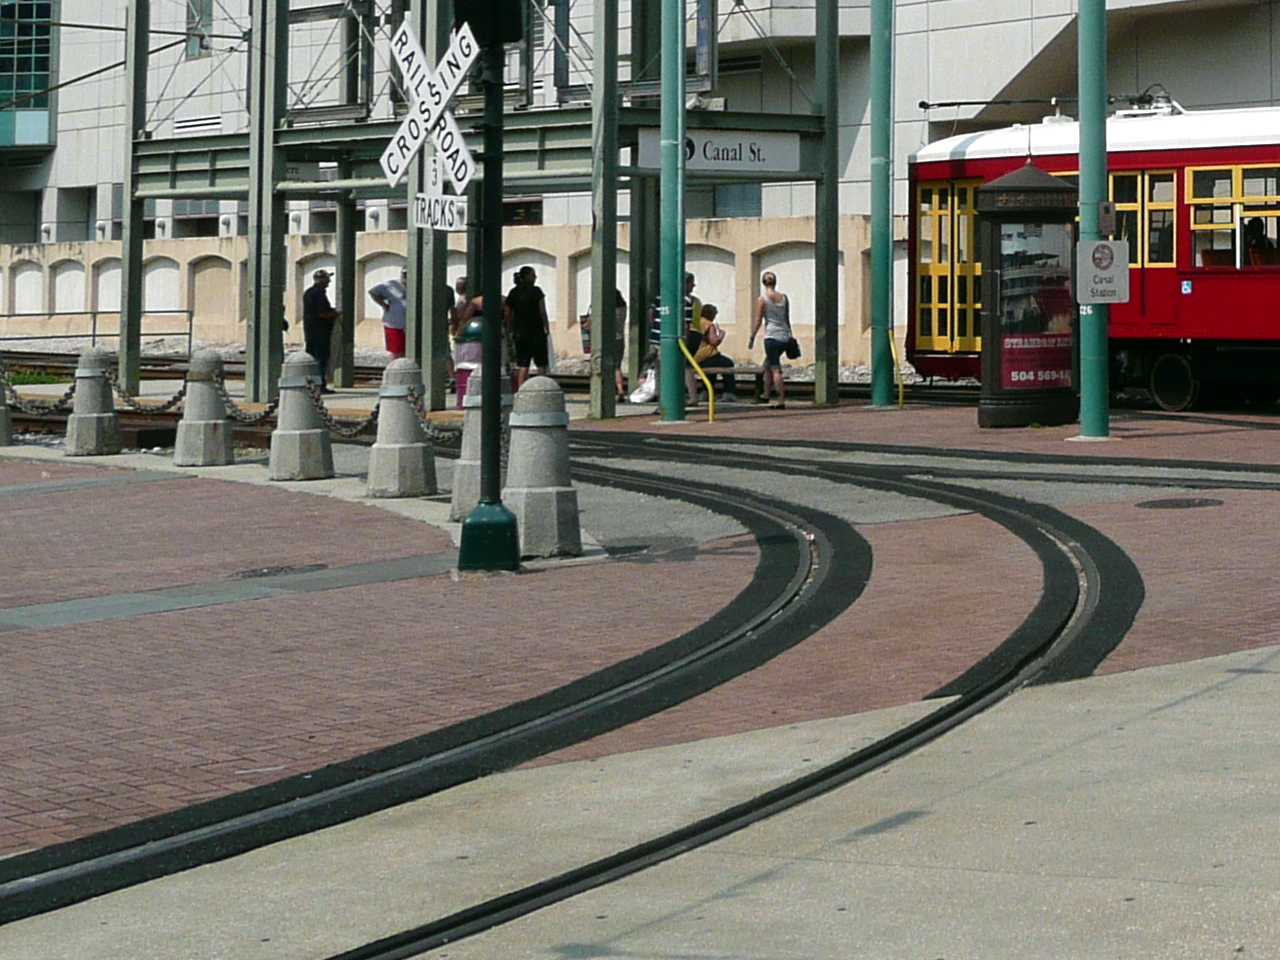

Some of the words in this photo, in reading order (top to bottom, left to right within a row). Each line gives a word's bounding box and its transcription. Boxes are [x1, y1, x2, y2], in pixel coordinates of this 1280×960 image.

[387, 36, 472, 175] CROSSING
[703, 140, 742, 162] Canal
[749, 142, 766, 162] St.
[414, 197, 454, 227] TRACKS
[1093, 274, 1114, 285] Canal
[1090, 288, 1117, 298] Station
[1011, 371, 1035, 382] 504
